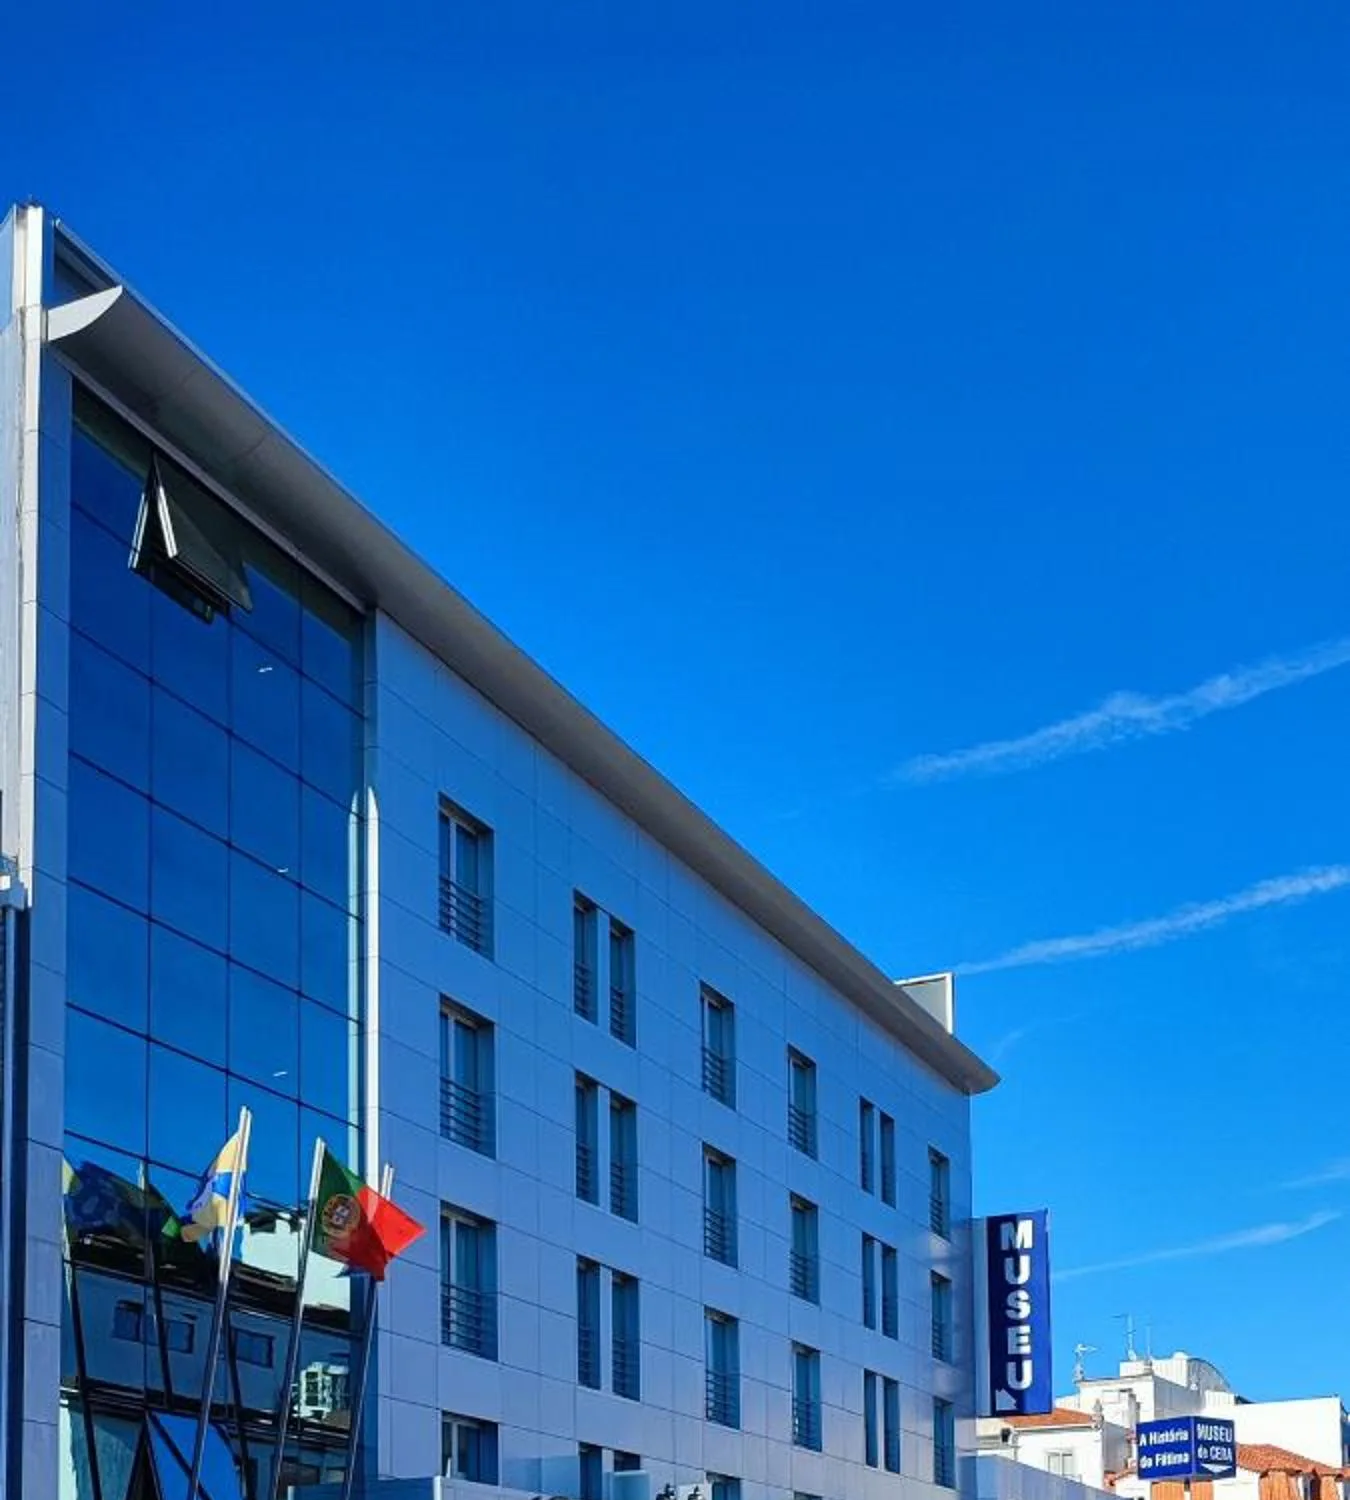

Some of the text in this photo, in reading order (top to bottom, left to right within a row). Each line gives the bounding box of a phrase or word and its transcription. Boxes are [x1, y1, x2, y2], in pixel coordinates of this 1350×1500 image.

[1000, 1219, 1034, 1391] MUSEU
[1140, 1427, 1189, 1446] A História
[1196, 1423, 1233, 1443] MUSEU
[1210, 1446, 1233, 1462] CERA
